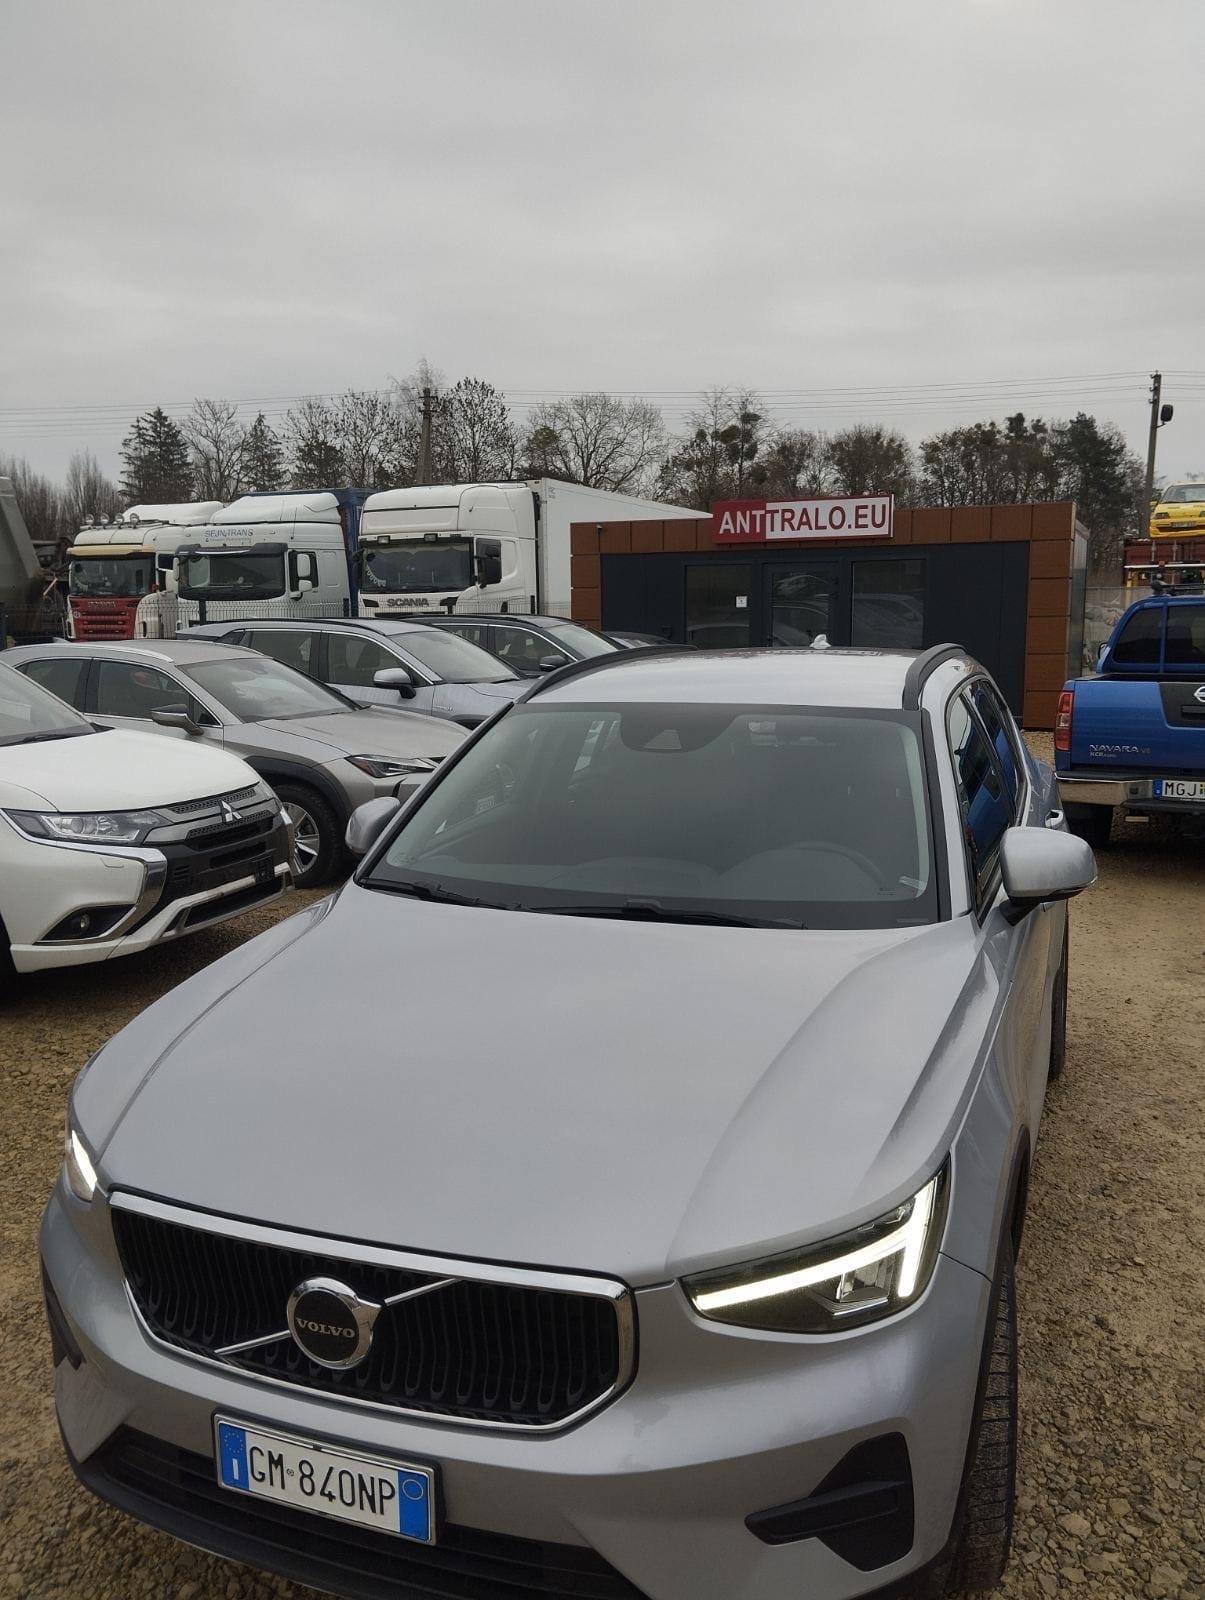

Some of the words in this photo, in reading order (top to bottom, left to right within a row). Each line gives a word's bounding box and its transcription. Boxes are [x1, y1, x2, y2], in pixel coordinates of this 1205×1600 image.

[719, 504, 887, 534] ANTTRALO.EU
[387, 598, 430, 607] SCANIA
[1089, 744, 1139, 753] NAVARA
[1164, 782, 1197, 796] MGJ
[295, 1317, 356, 1338] VOLVO
[249, 1446, 285, 1490] GM
[298, 1459, 396, 1515] 840NP
